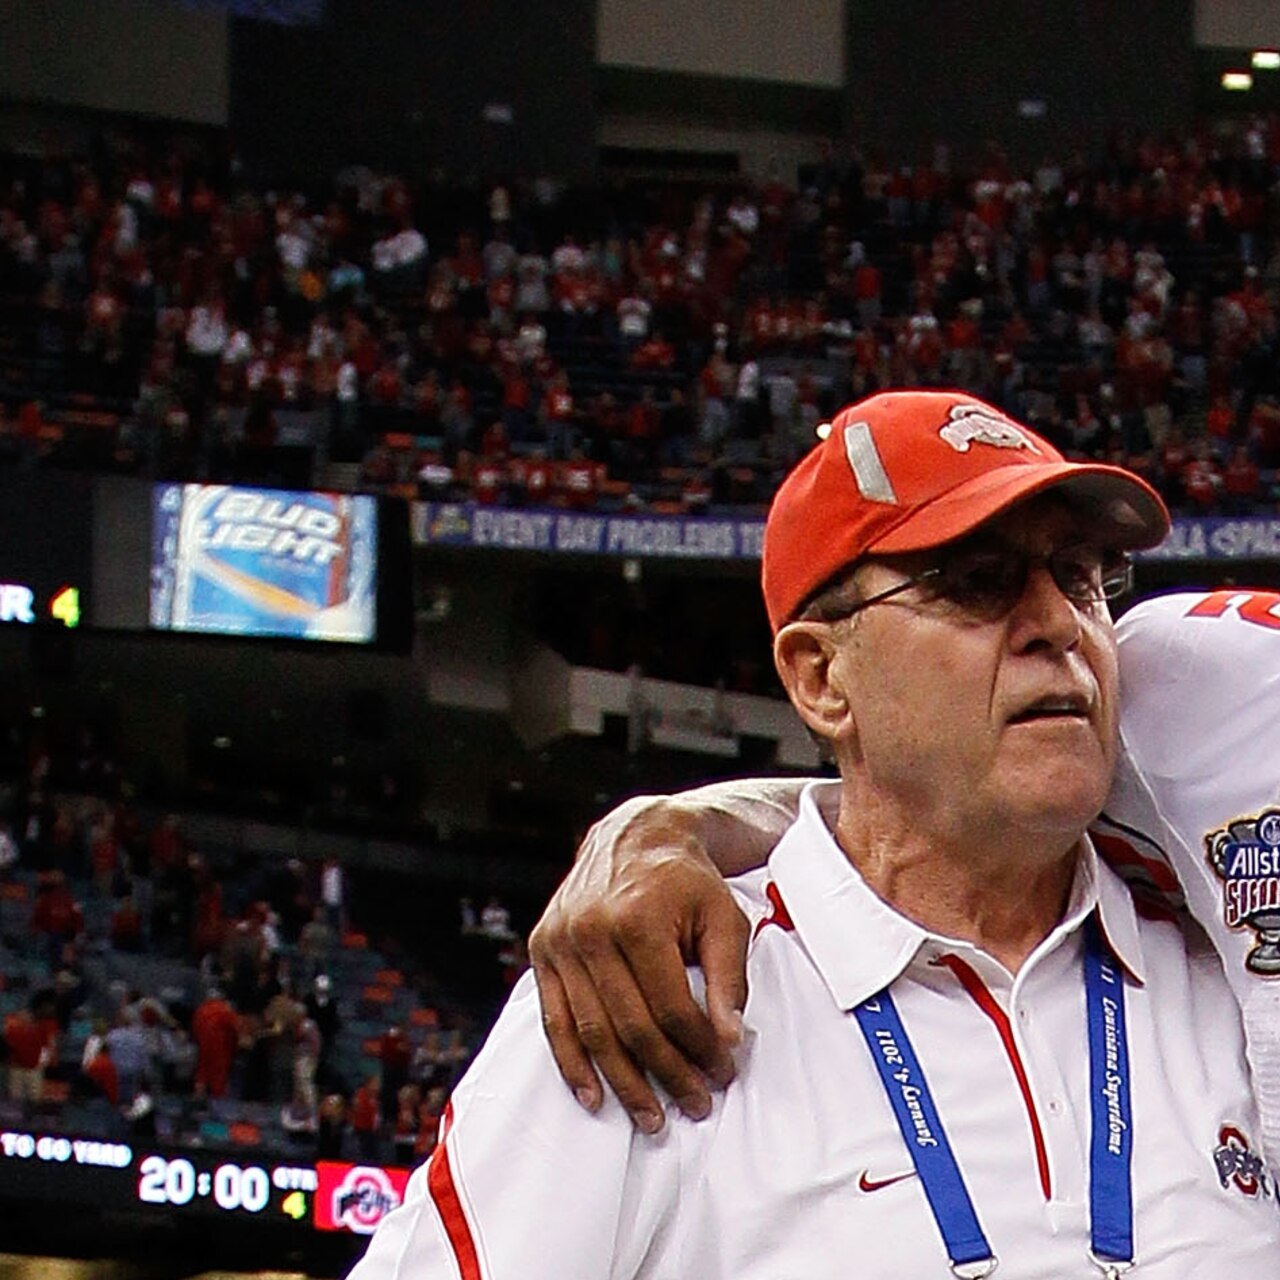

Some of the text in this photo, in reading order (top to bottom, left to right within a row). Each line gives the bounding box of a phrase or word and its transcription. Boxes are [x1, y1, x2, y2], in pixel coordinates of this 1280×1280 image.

[213, 493, 341, 540] BUD
[473, 508, 551, 546] EVENT
[555, 513, 604, 549] DAY
[196, 519, 344, 564] LIGHT
[51, 585, 80, 628] 4
[875, 1030, 904, 1065] 2011
[1103, 996, 1121, 1071] Louisiana
[901, 1085, 938, 1147] January
[1103, 1070, 1127, 1156] Superdome
[138, 1155, 270, 1212] 20:00
